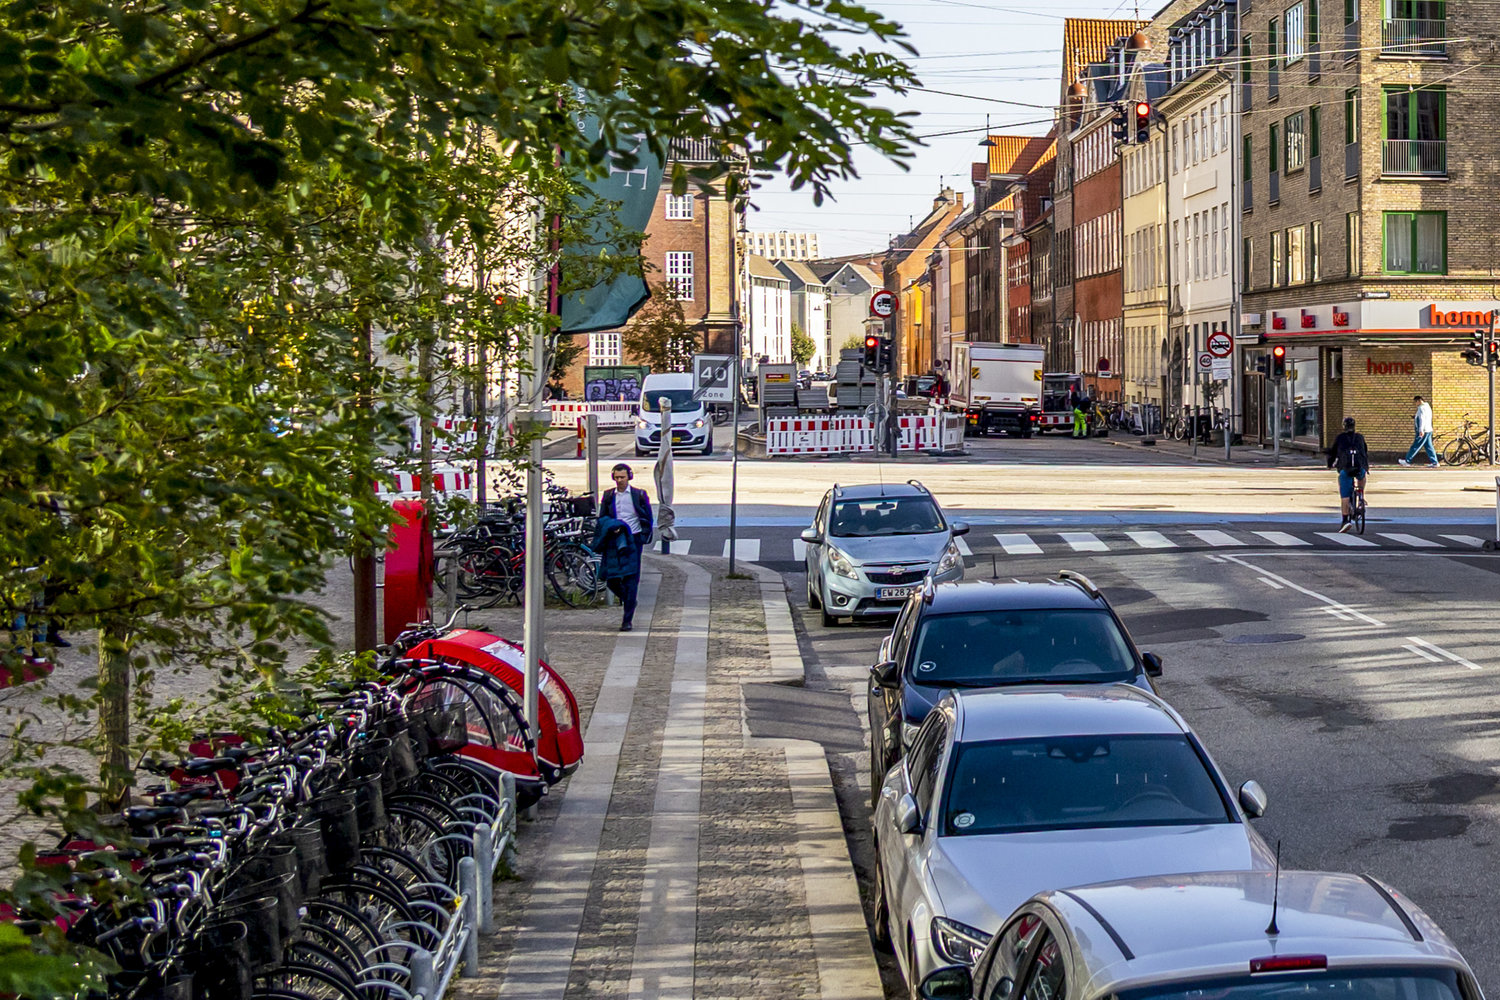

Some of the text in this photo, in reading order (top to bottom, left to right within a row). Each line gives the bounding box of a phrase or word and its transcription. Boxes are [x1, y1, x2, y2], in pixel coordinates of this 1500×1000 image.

[700, 366, 728, 382] 40
[1367, 357, 1414, 375] home
[895, 589, 905, 597] 28
